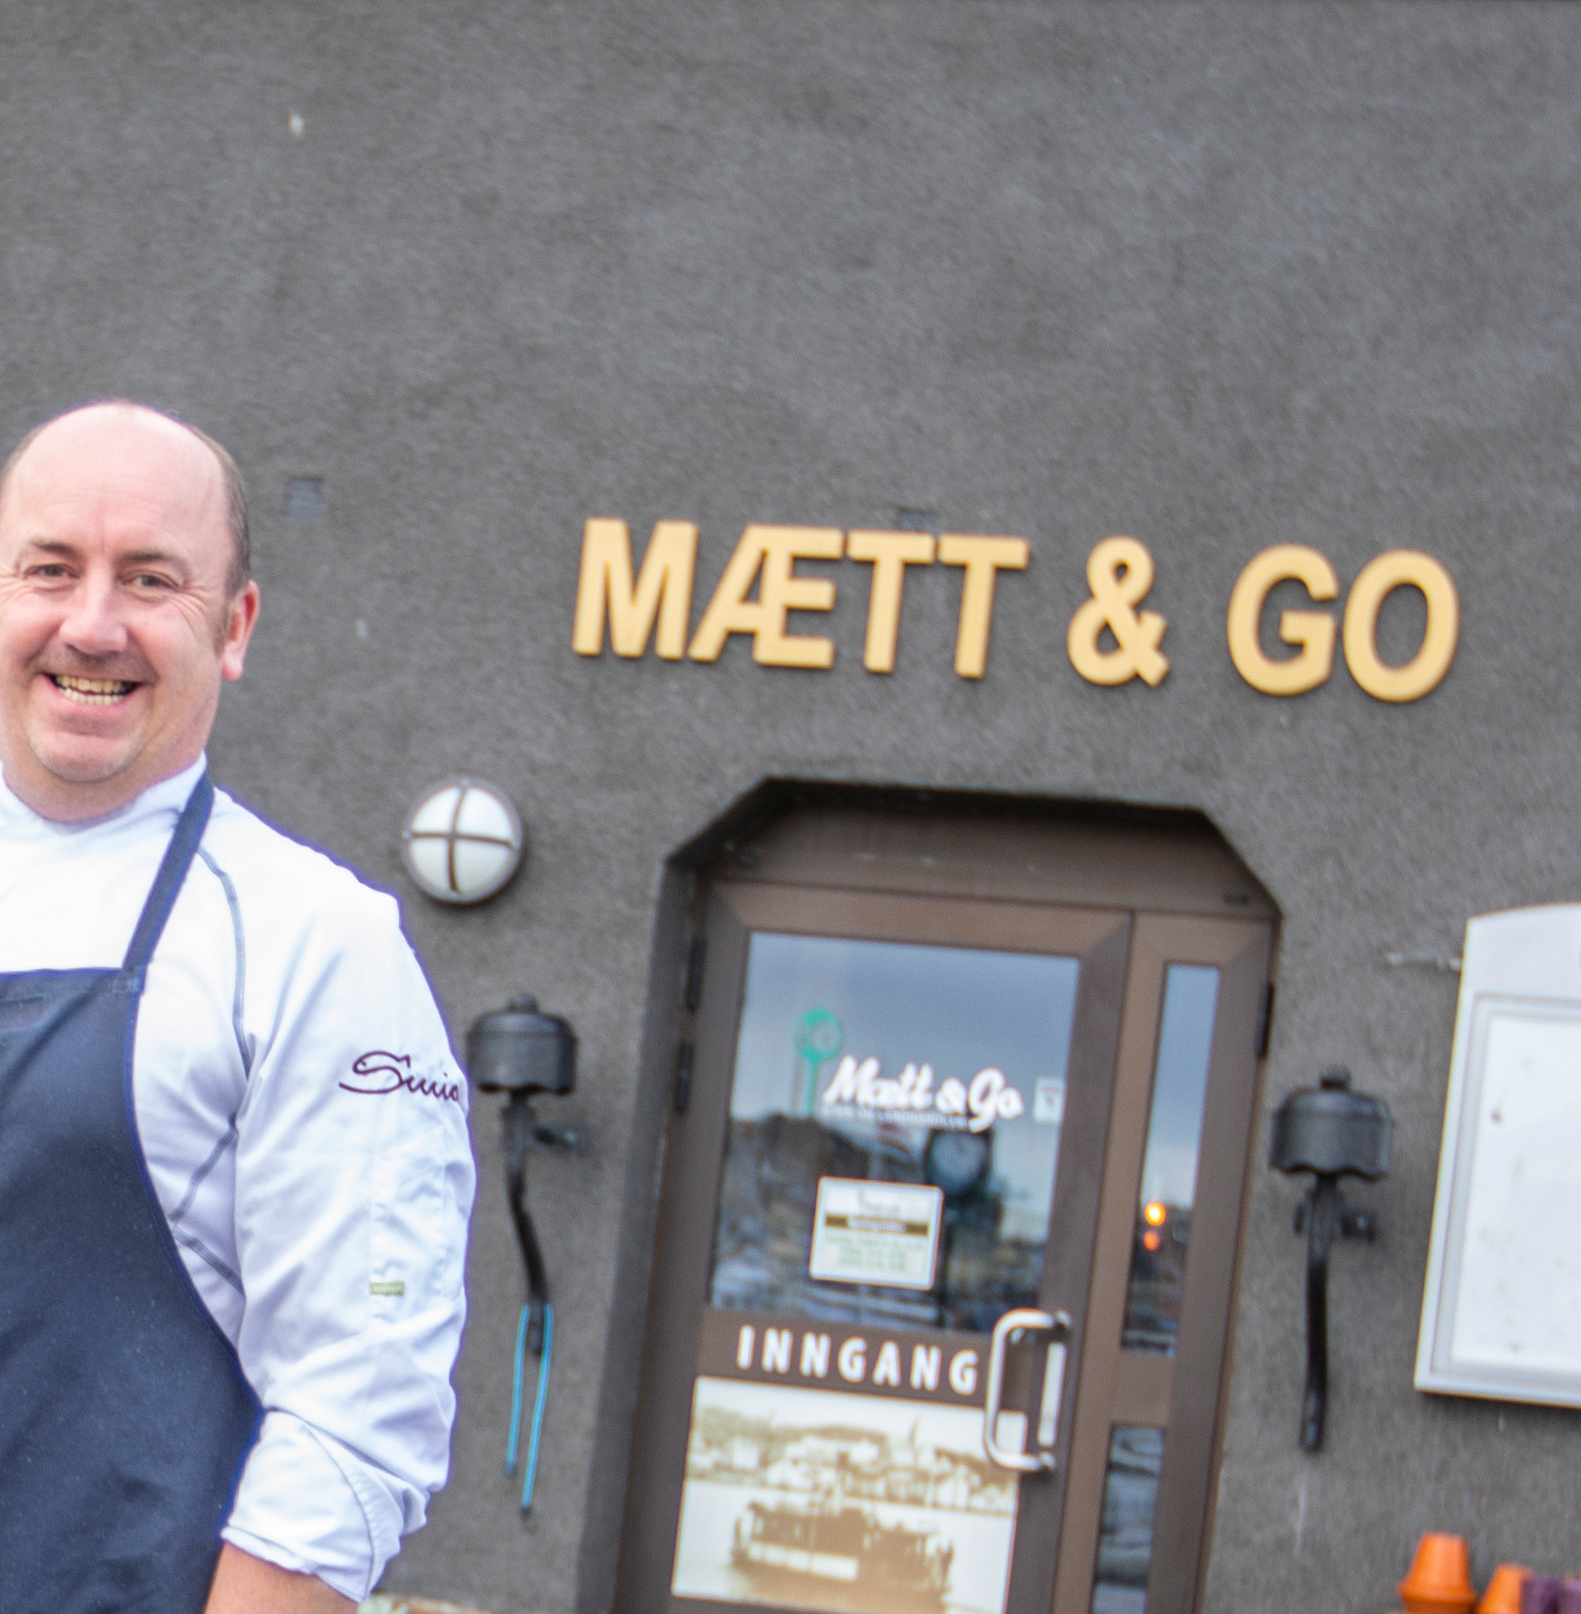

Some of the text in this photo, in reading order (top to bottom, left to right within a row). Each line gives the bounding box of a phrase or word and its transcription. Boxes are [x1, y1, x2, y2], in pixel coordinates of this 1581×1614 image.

[572, 516, 1459, 703] MÆTT & GO
[822, 1055, 934, 1111] Mætt
[936, 1077, 968, 1116] &
[967, 1067, 1024, 1134] Go
[736, 1323, 979, 1396] INNGANG
